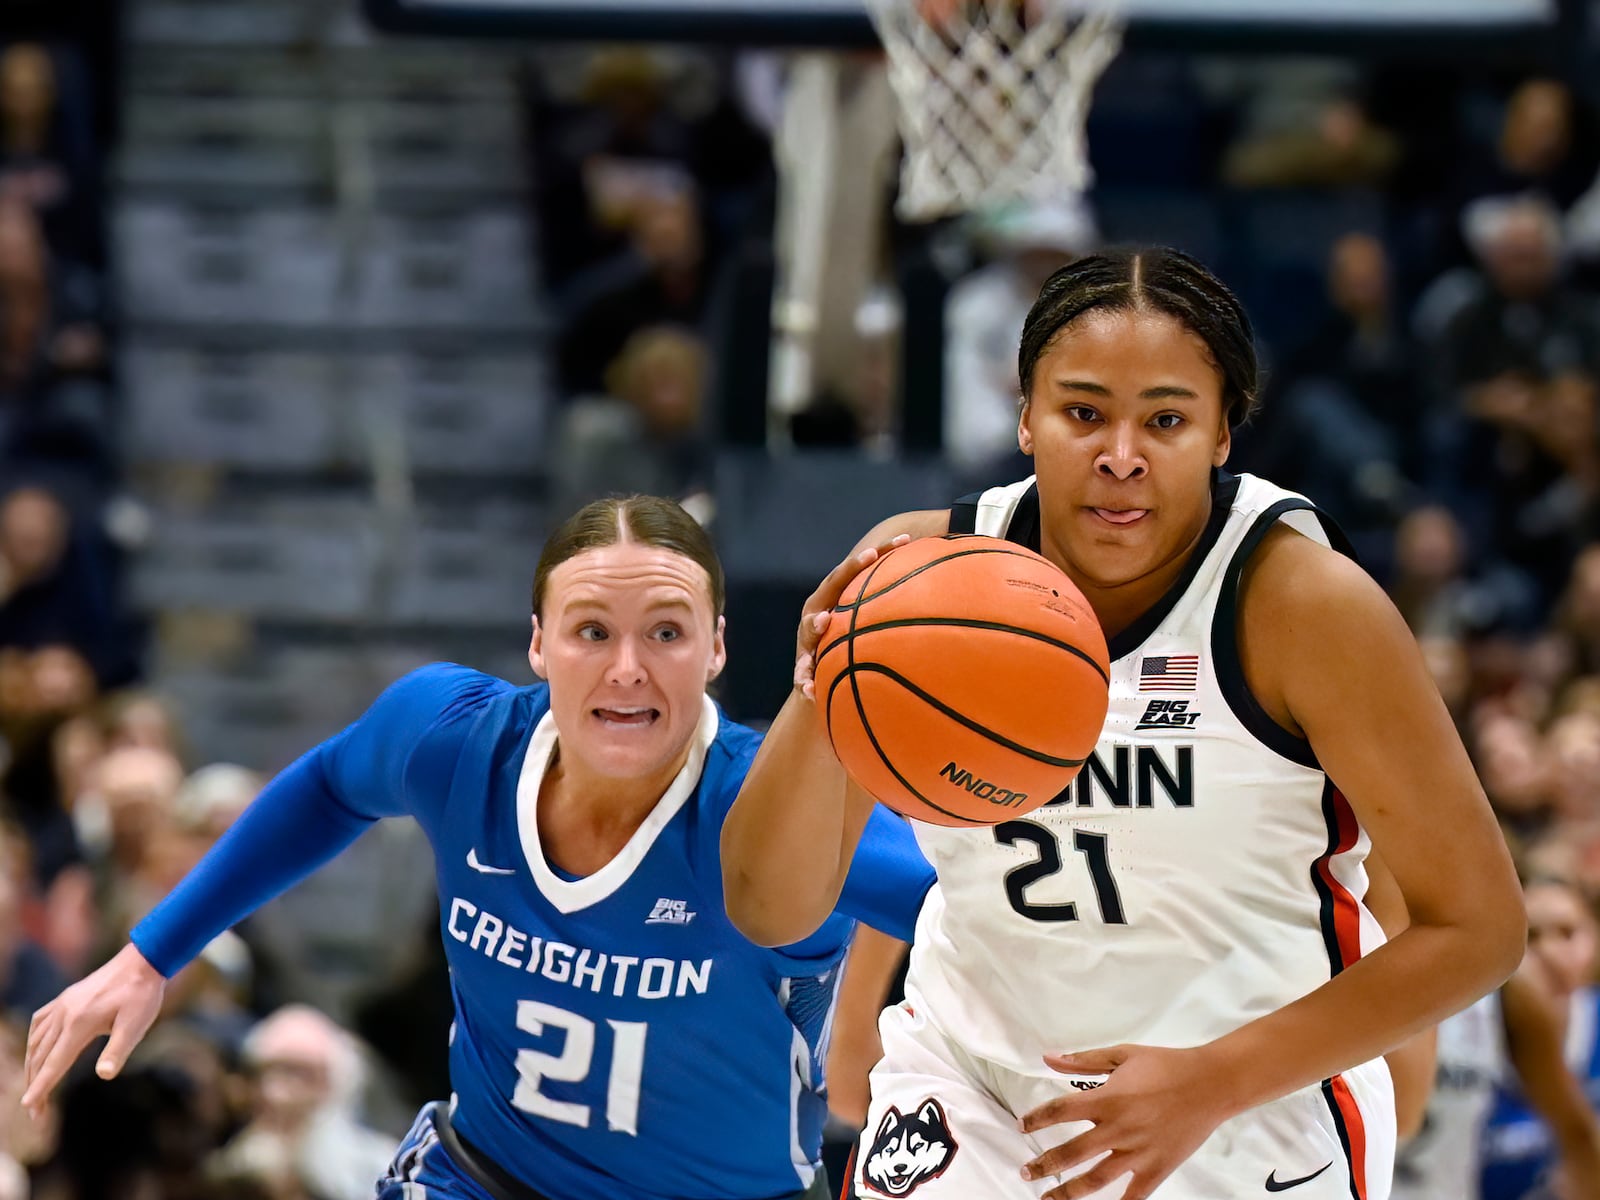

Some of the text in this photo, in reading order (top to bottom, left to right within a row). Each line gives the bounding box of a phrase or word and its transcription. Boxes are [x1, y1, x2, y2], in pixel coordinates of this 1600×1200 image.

[1139, 712, 1202, 725] EAST
[1146, 699, 1190, 713] BIG
[939, 761, 1028, 808] UCONN
[992, 817, 1128, 925] 21
[448, 896, 713, 999] CREIGHTON
[510, 999, 649, 1138] 21
